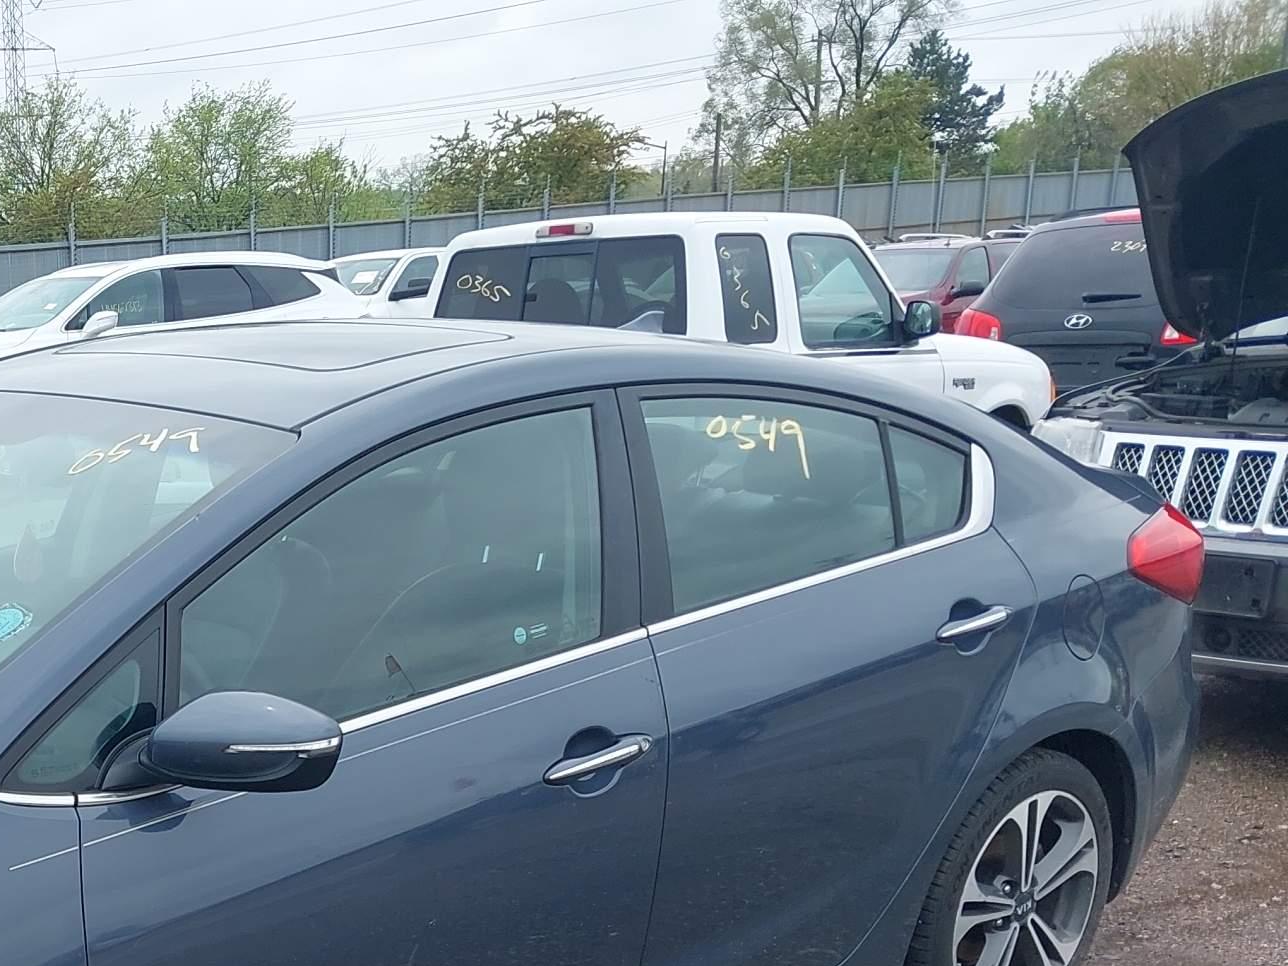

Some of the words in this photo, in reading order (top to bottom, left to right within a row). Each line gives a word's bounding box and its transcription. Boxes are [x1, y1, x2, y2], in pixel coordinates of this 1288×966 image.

[456, 274, 511, 301] 0365
[68, 427, 205, 475] 0549
[707, 415, 810, 479] 0549
